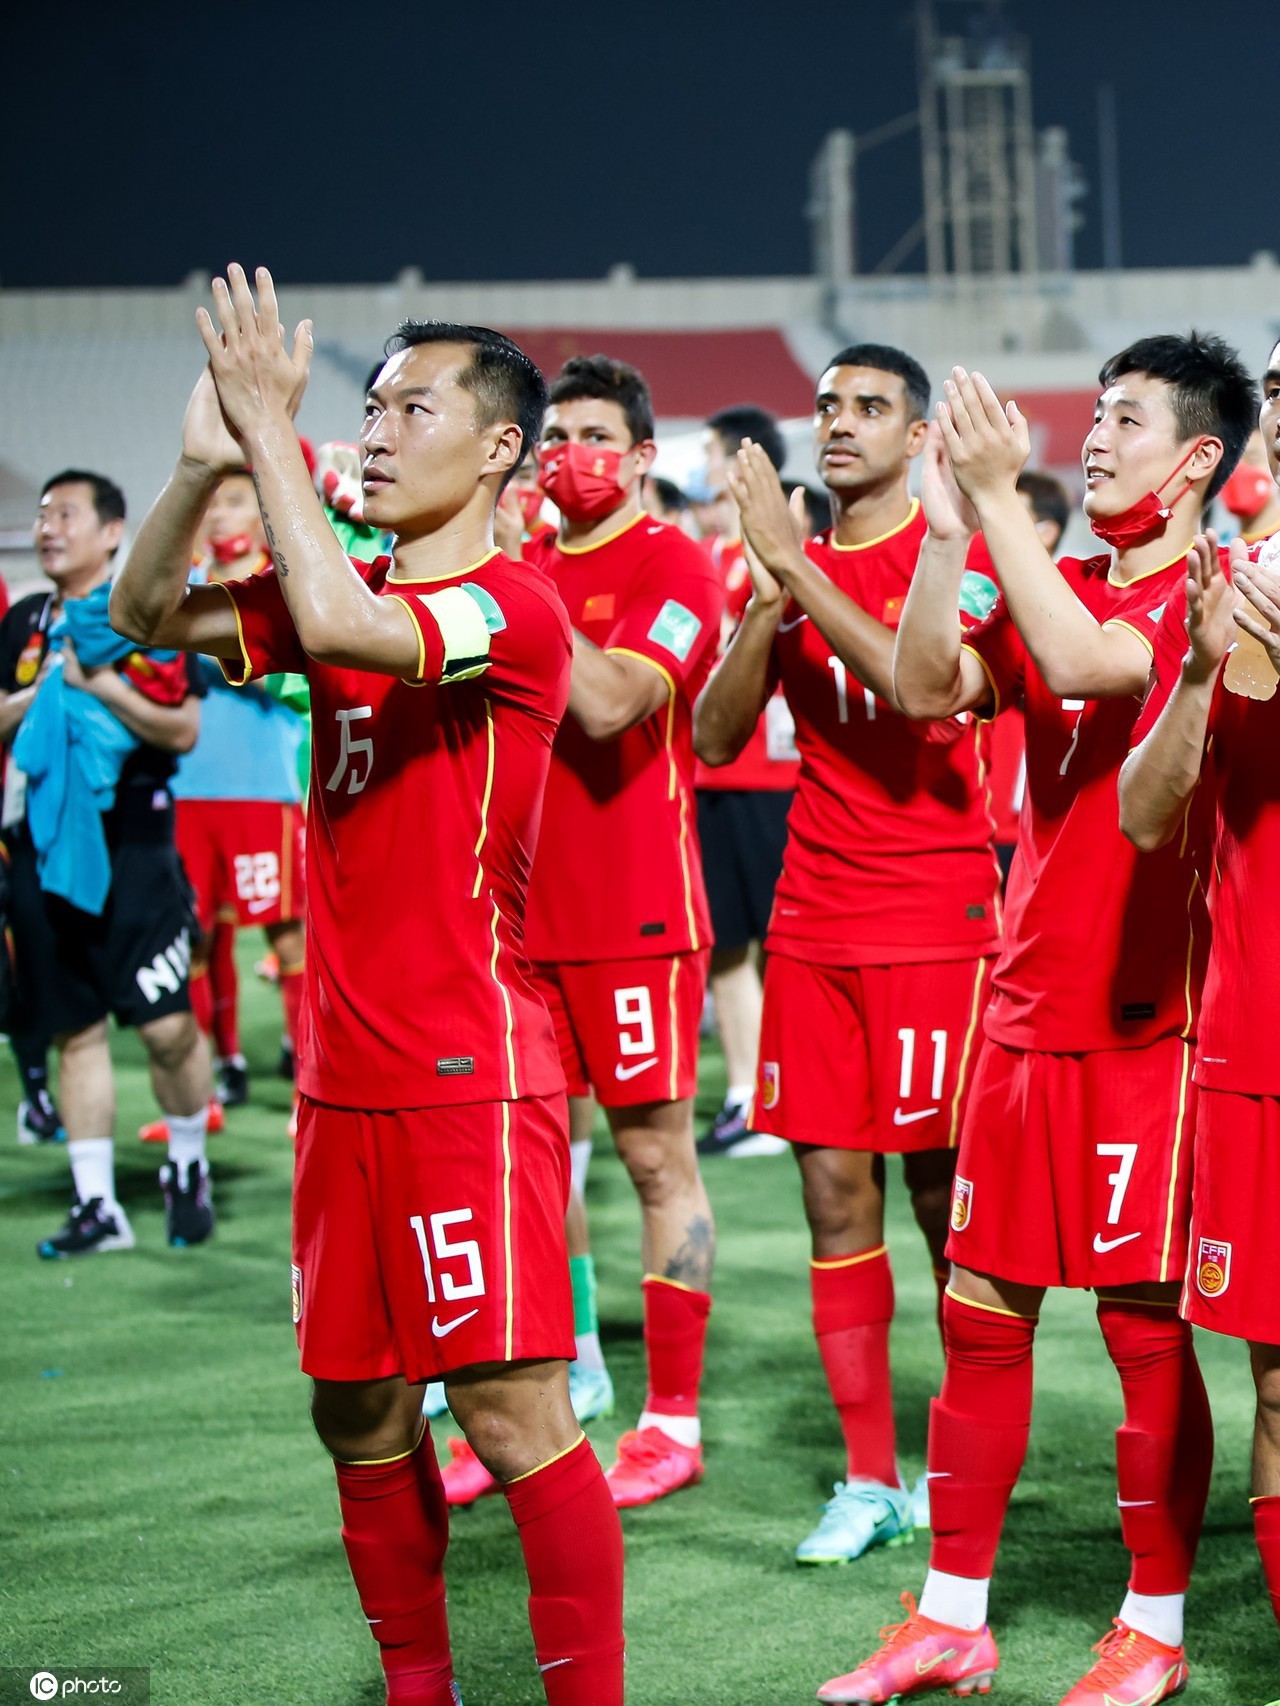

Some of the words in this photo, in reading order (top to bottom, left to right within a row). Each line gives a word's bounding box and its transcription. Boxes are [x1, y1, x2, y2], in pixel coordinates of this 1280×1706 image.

[325, 705, 374, 795] 15
[614, 985, 656, 1056] 9
[898, 1028, 947, 1100] 11
[1097, 1143, 1139, 1225] 7
[410, 1207, 486, 1303] 15
[1202, 1243, 1227, 1257] CFA
